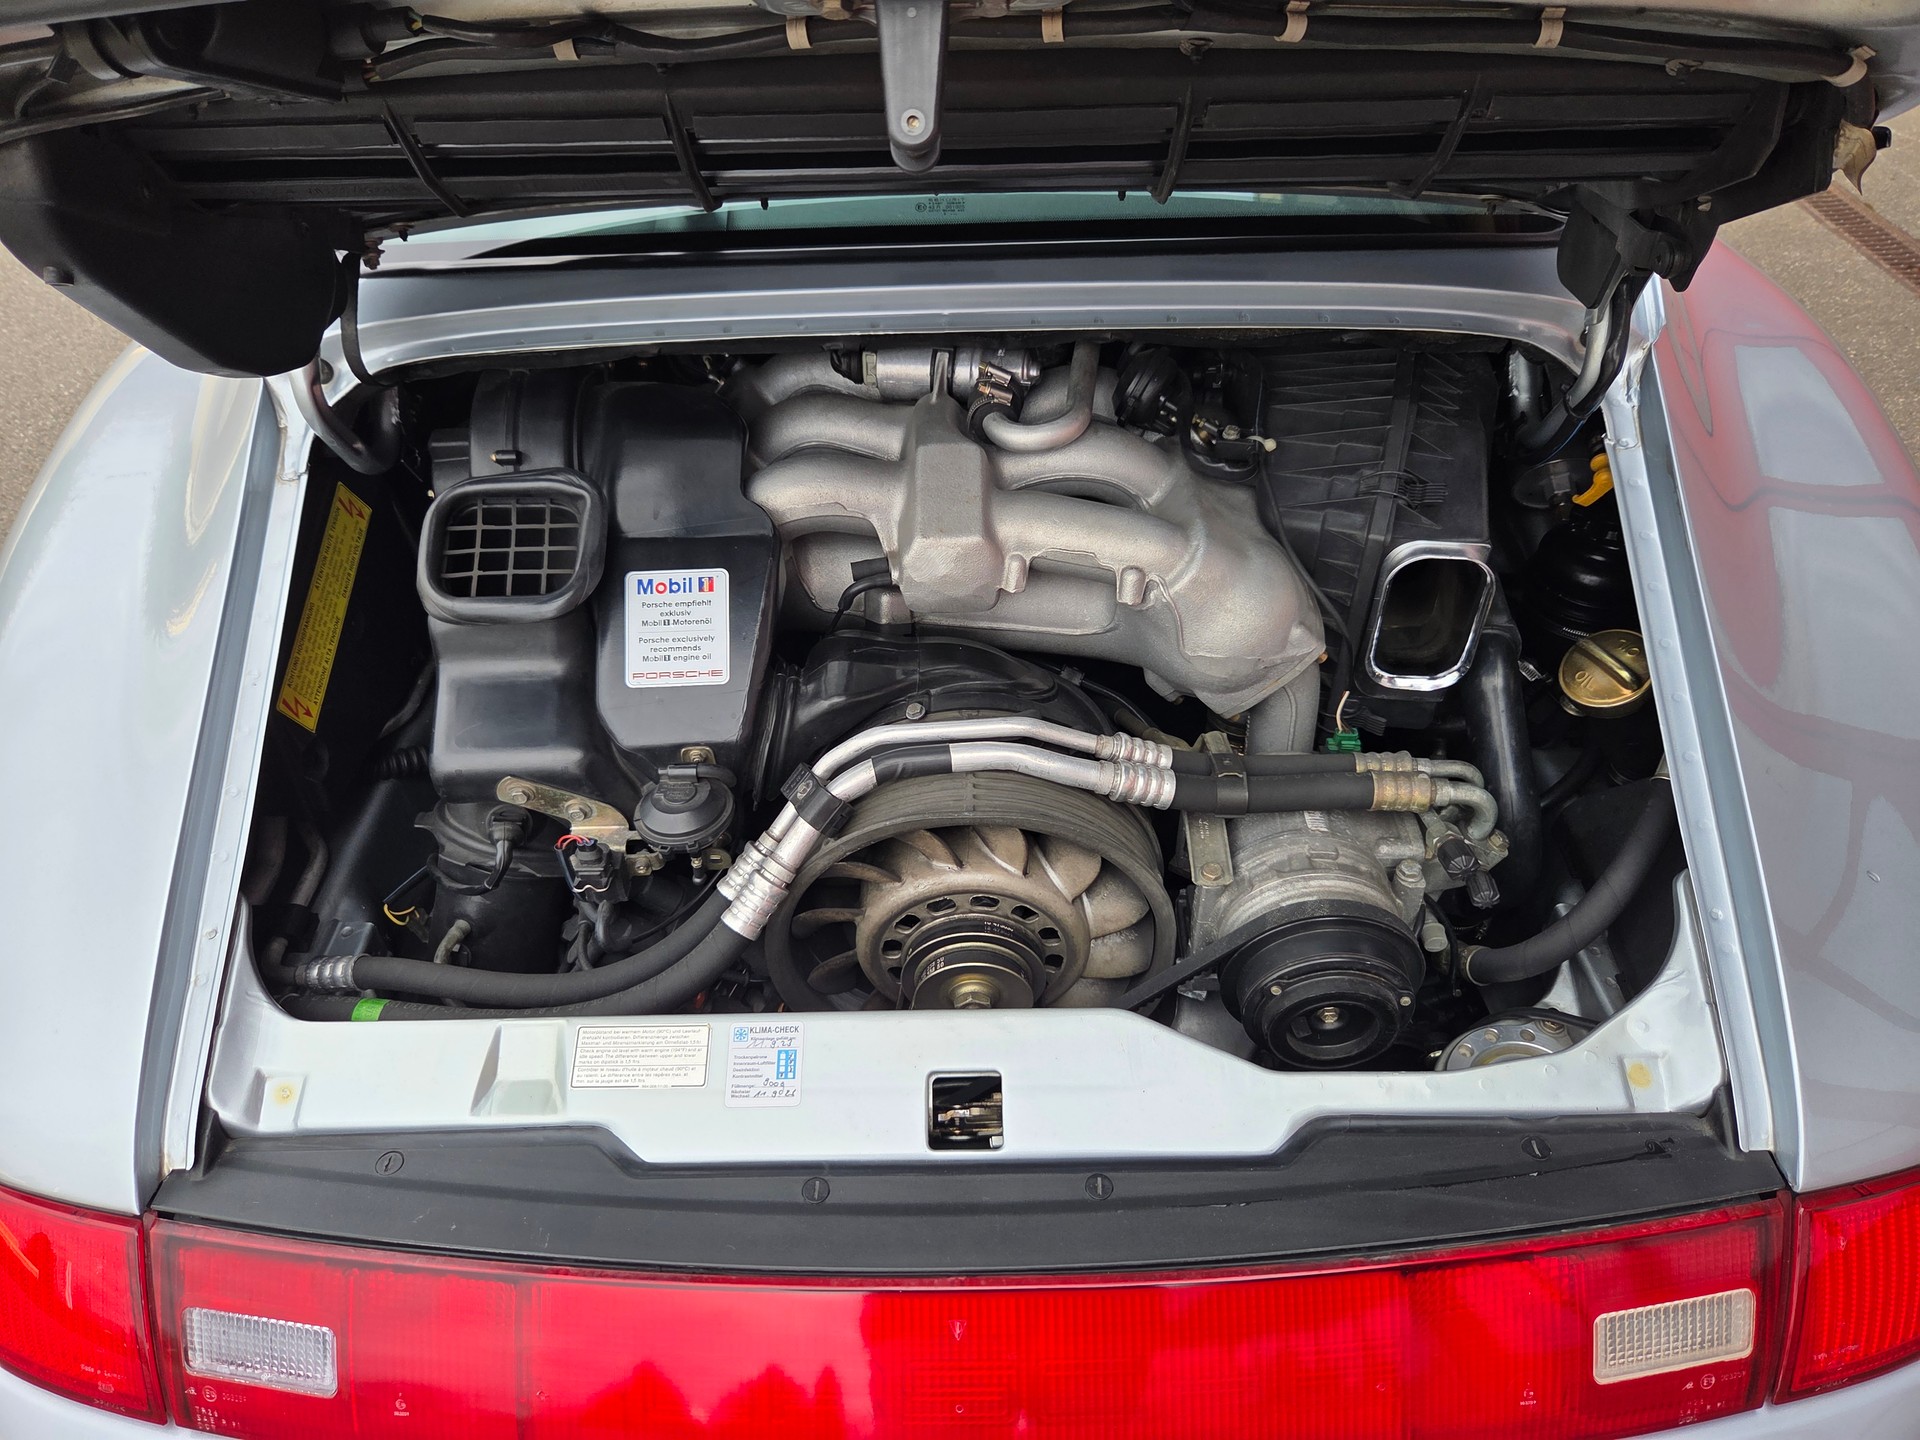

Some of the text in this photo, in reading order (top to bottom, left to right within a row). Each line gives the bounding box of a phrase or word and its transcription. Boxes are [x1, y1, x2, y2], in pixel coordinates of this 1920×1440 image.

[314, 554, 327, 590] ATTENTION
[341, 571, 352, 598] DANGER
[353, 527, 364, 556] VOLTAGE
[637, 577, 692, 595] Mobil
[633, 670, 723, 680] PORSCHE
